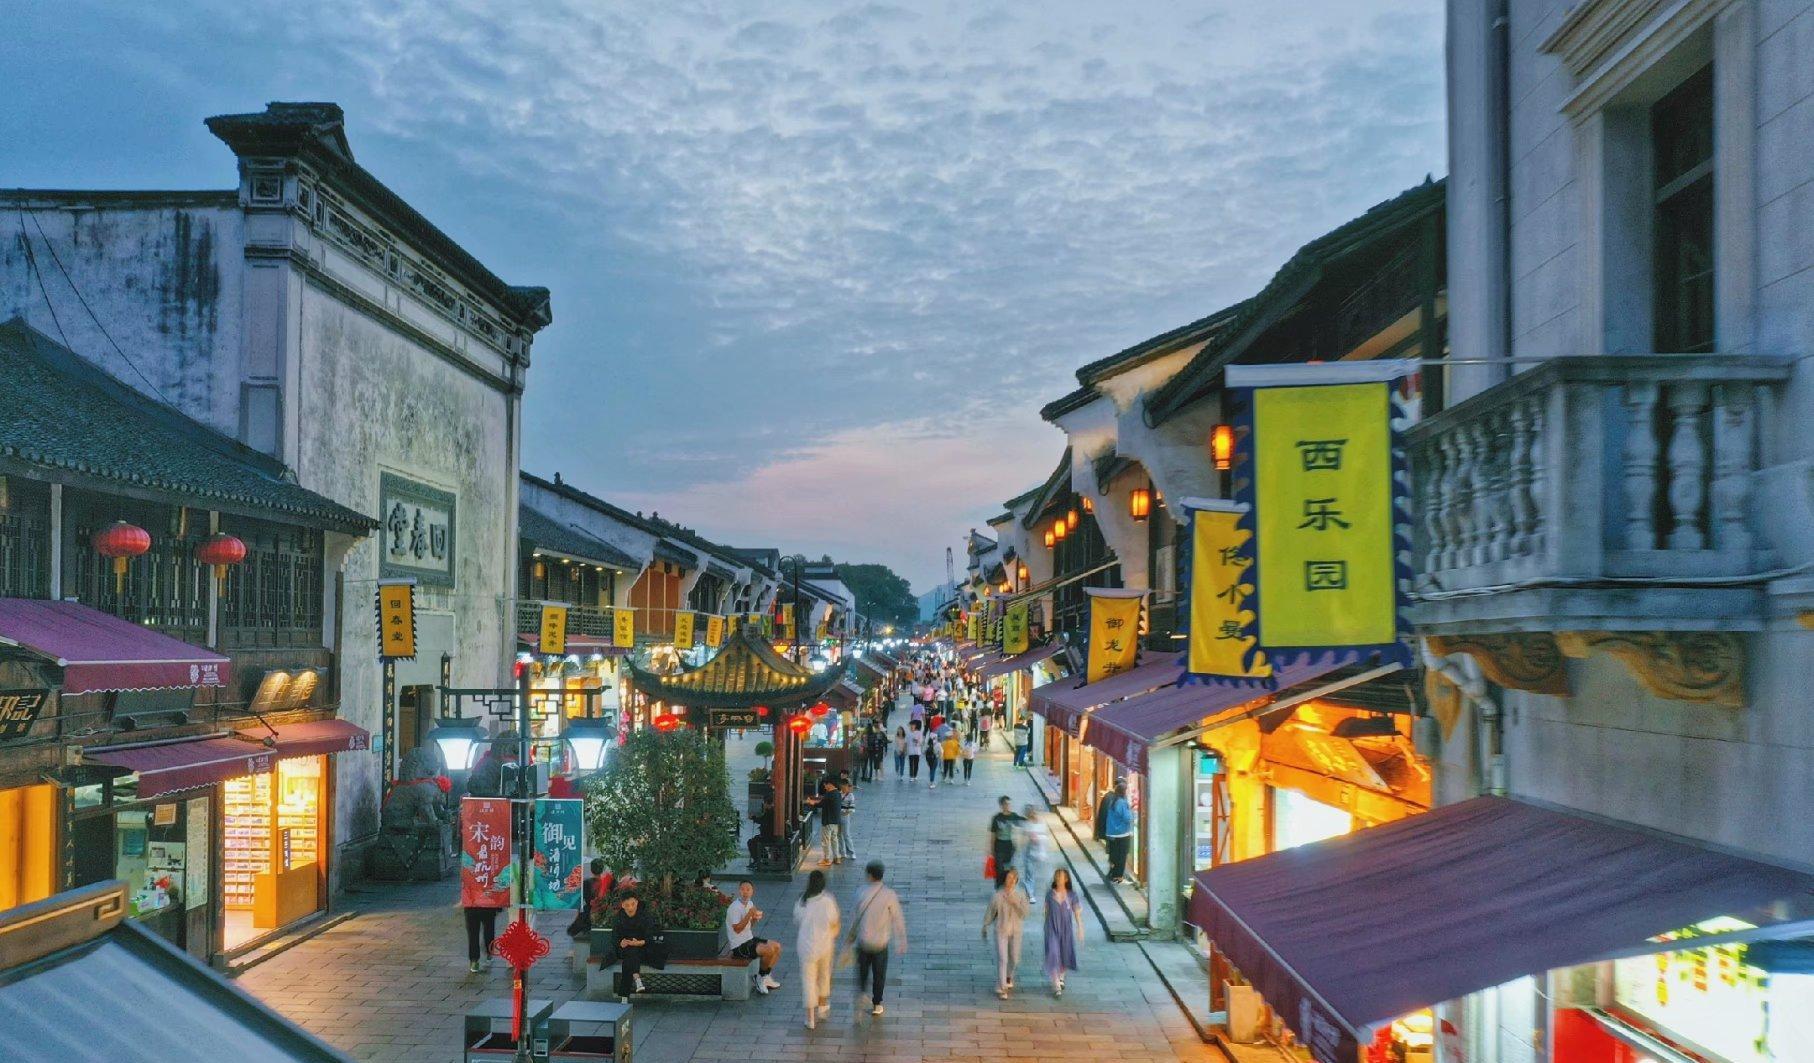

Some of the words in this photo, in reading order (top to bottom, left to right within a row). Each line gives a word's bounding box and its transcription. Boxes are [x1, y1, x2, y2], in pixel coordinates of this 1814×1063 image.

[388, 501, 446, 561] 回春堂
[1295, 438, 1351, 592] 西乐园
[390, 599, 404, 642] 回春堂
[469, 821, 505, 851] 宋韵
[542, 822, 577, 851] 御见
[548, 846, 561, 892] 清河坊
